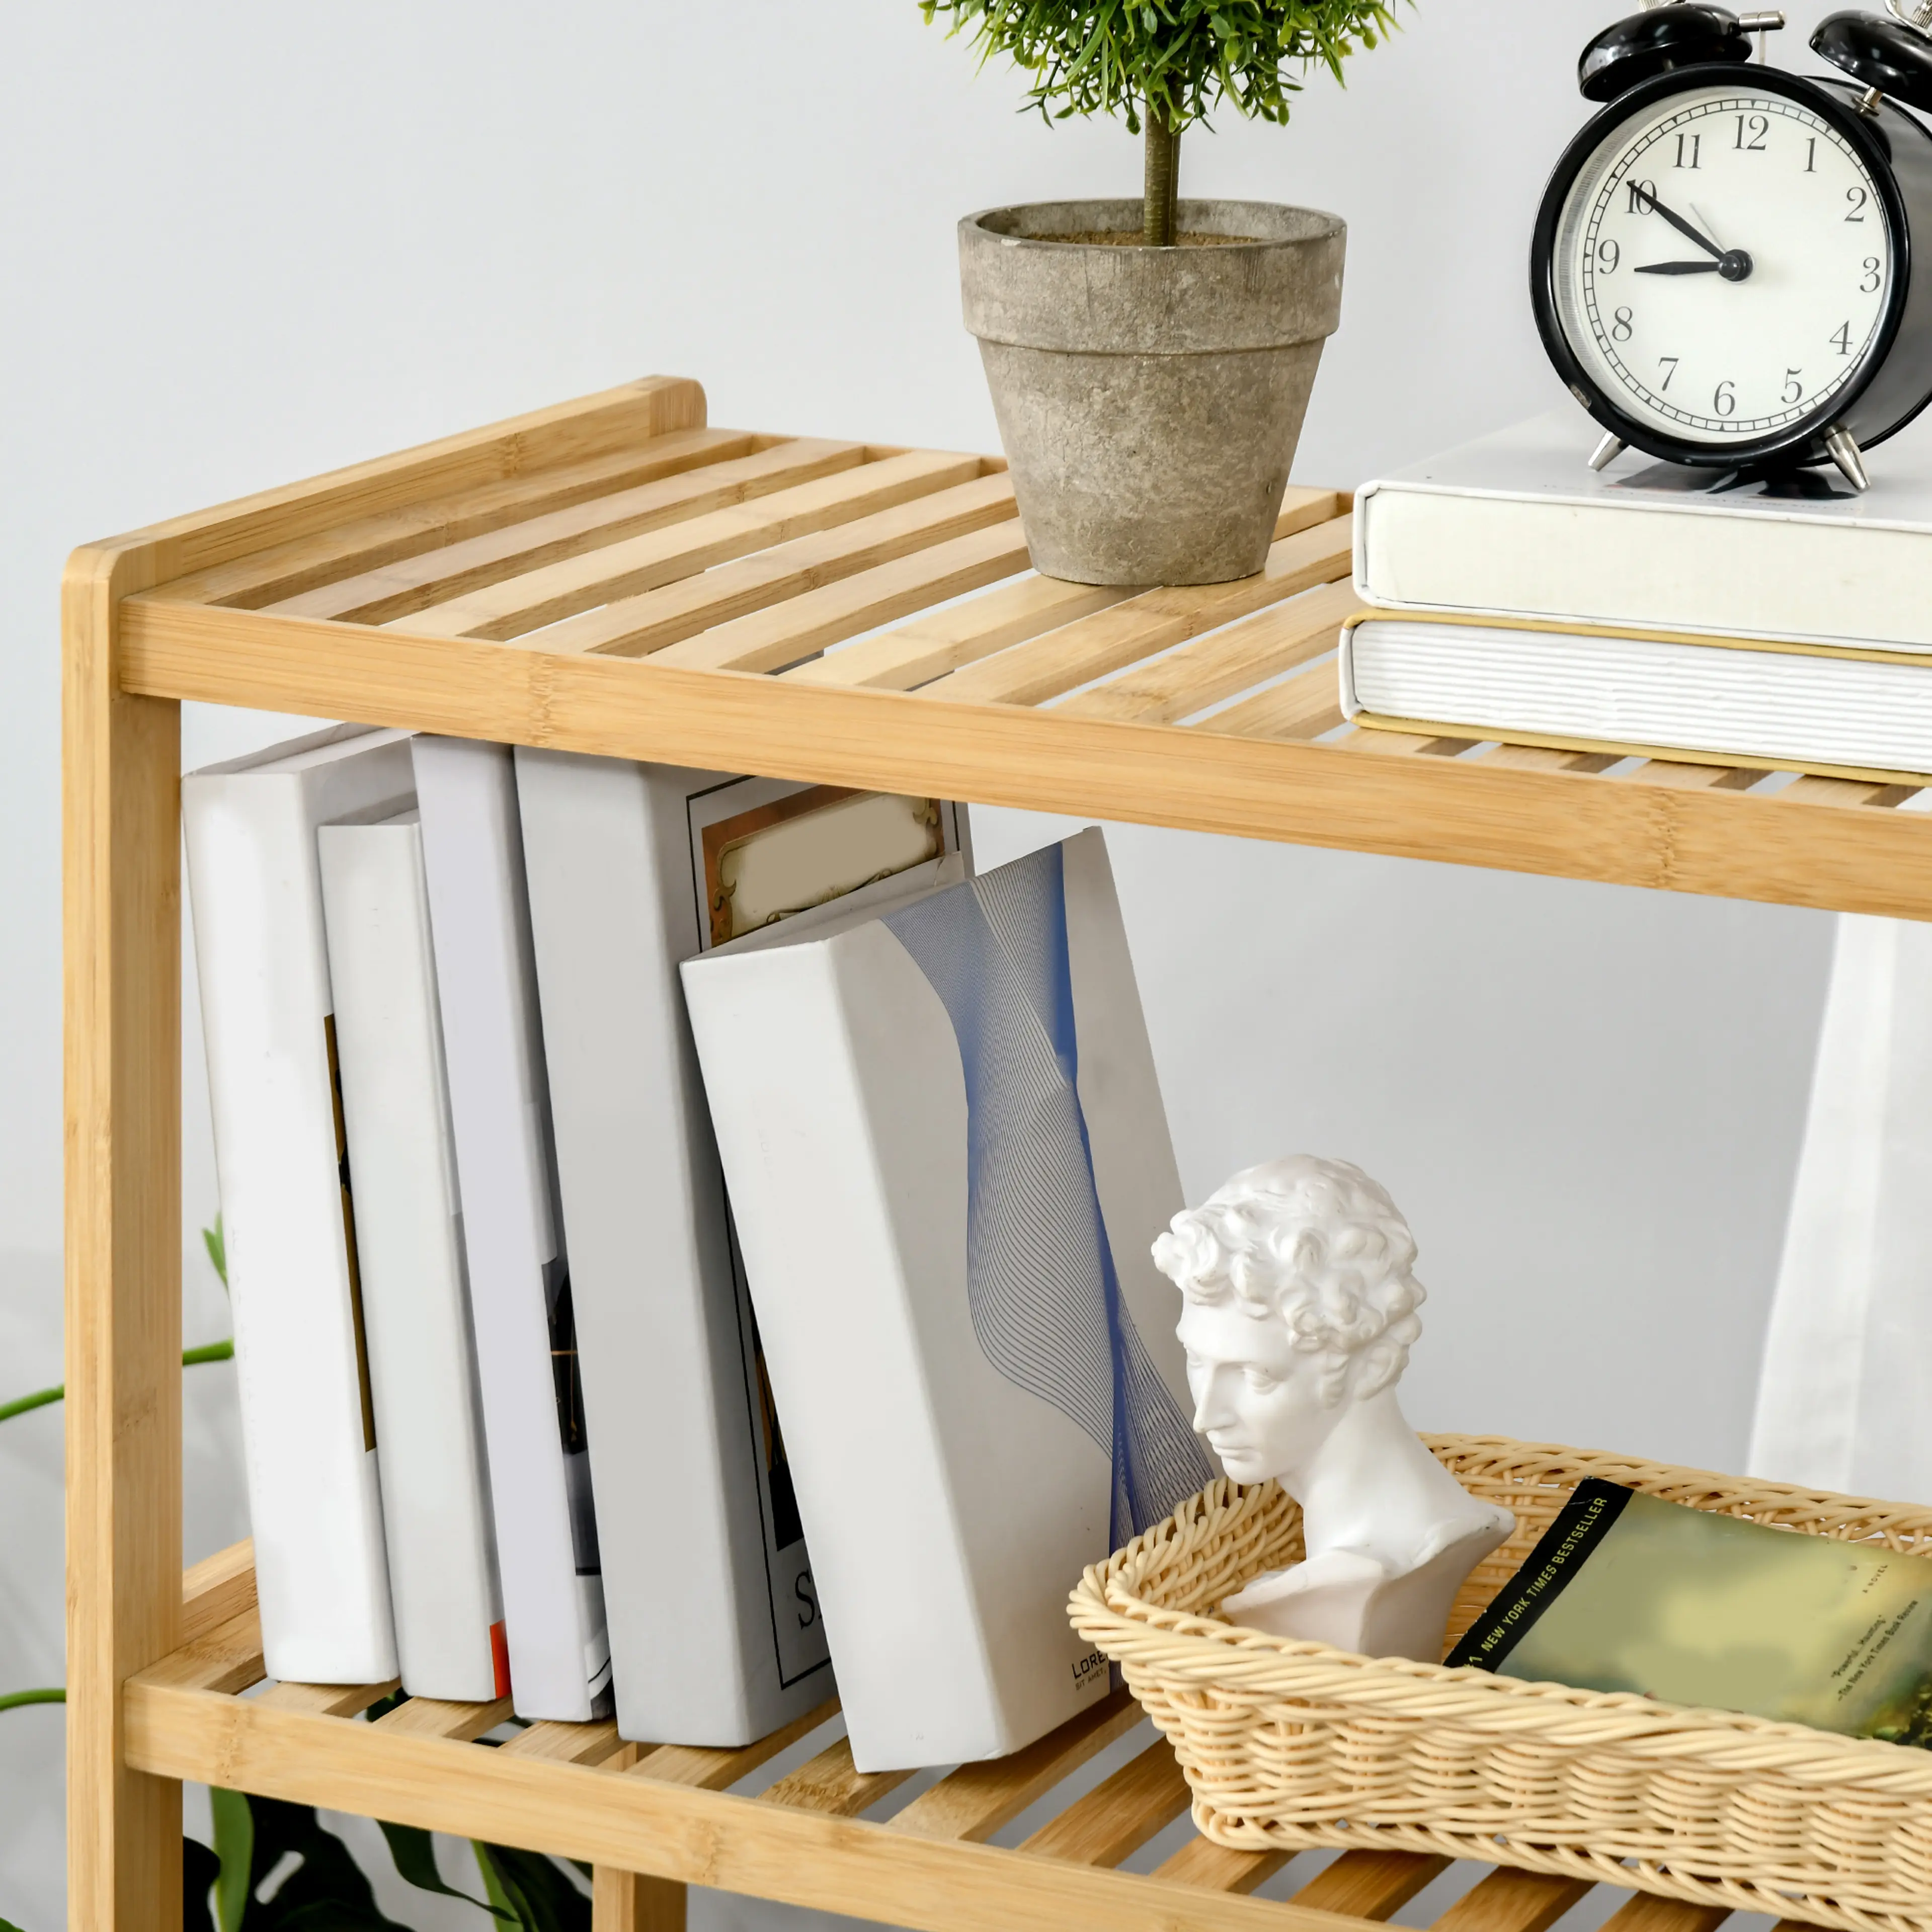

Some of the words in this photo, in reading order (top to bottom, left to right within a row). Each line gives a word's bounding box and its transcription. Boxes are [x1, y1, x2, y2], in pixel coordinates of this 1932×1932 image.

[1732, 115, 1768, 150] 12
[1672, 133, 1702, 169] 11
[1803, 137, 1817, 173] 1
[1624, 179, 1657, 215] 10
[1844, 186, 1867, 222] 2
[1598, 239, 1620, 274] 9
[1860, 257, 1880, 293] 3
[1612, 306, 1634, 342] 8
[1829, 320, 1853, 355] 4
[1657, 357, 1679, 391] 7
[1781, 368, 1802, 403] 5
[1713, 380, 1735, 416] 6
[1481, 1626, 1505, 1652] NEW
[1502, 1597, 1530, 1626] YORK
[1526, 1565, 1557, 1597] TIMES
[1552, 1497, 1607, 1564] BESTSELLER
[1867, 1565, 1888, 1586] NOVEL
[795, 1568, 822, 1630] S
[1072, 1650, 1109, 1679] LORE
